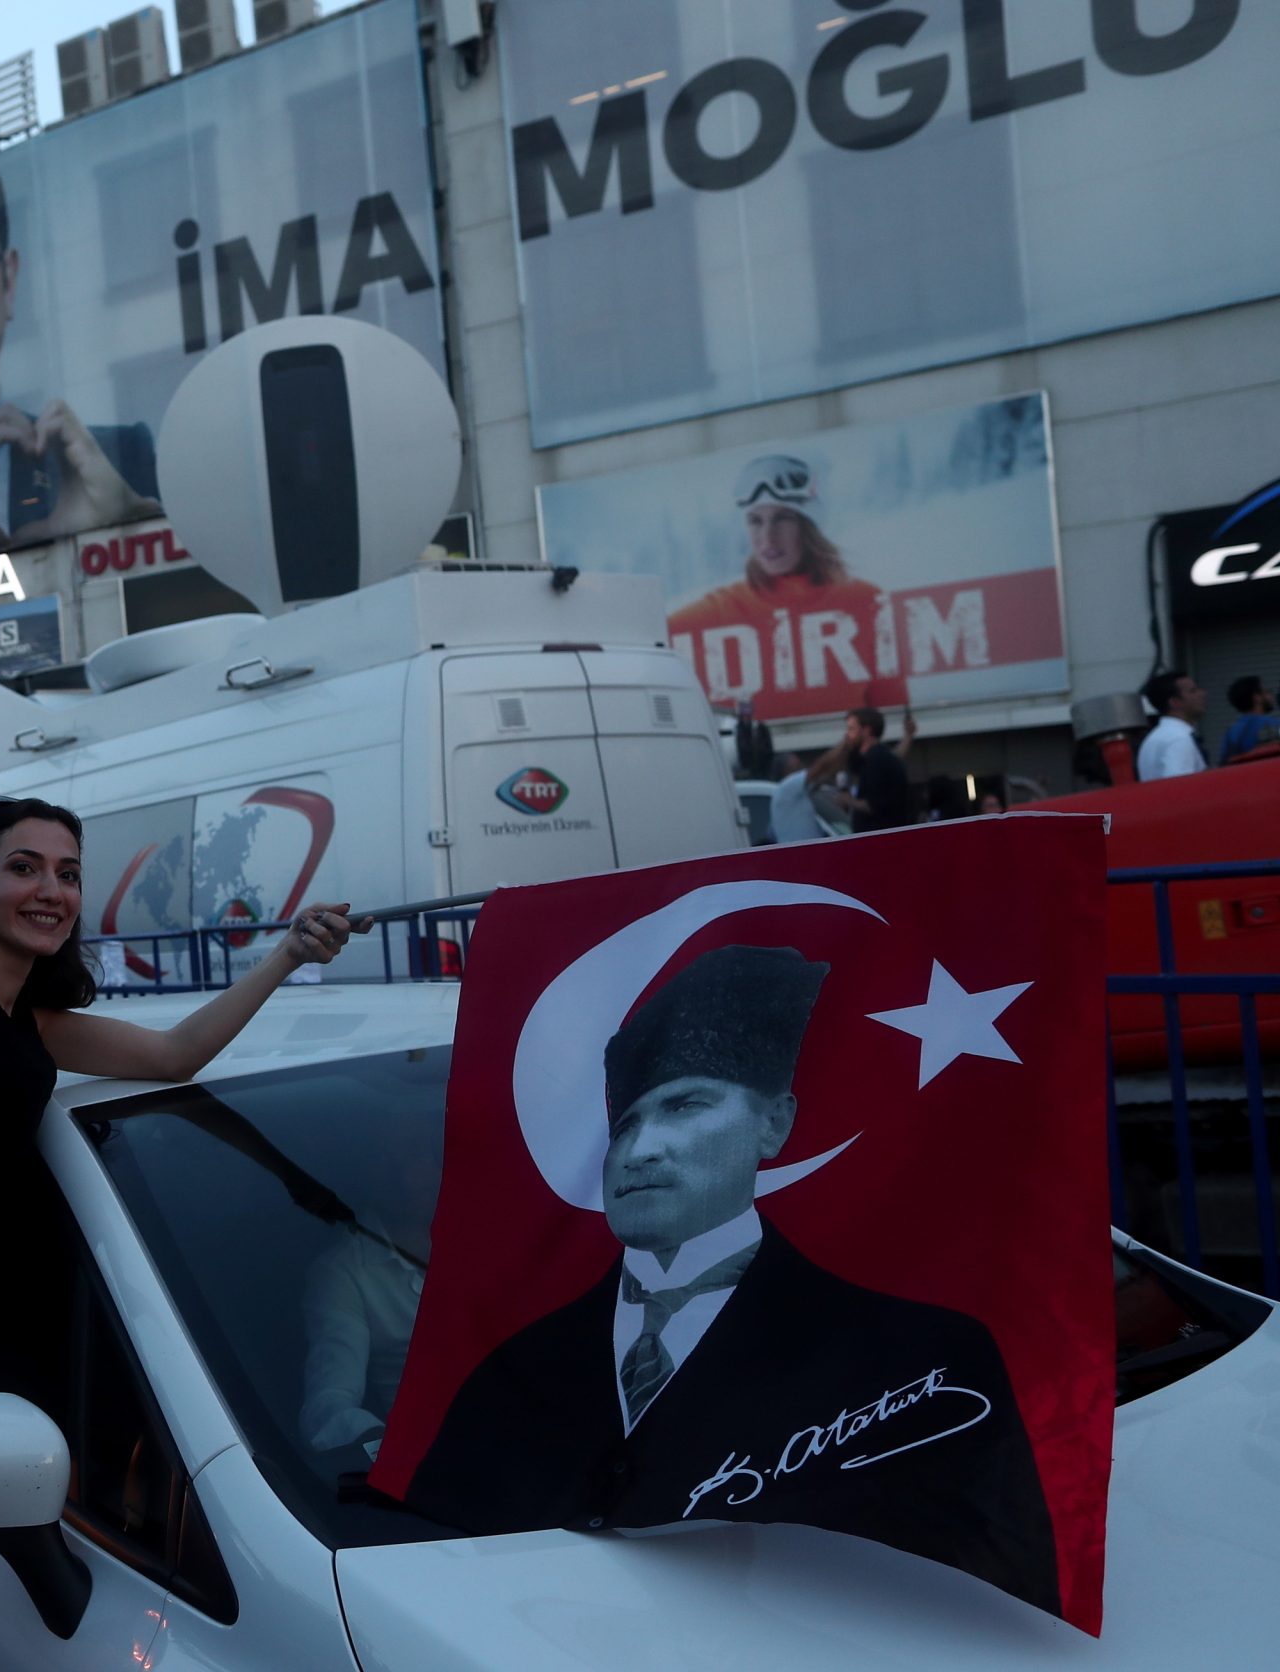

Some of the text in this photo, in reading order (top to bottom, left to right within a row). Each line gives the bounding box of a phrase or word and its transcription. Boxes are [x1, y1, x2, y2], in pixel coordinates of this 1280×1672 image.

[511, 0, 1240, 242] MOĞLU
[521, 782, 560, 799] TRT
[774, 1367, 991, 1480] Atatürk
